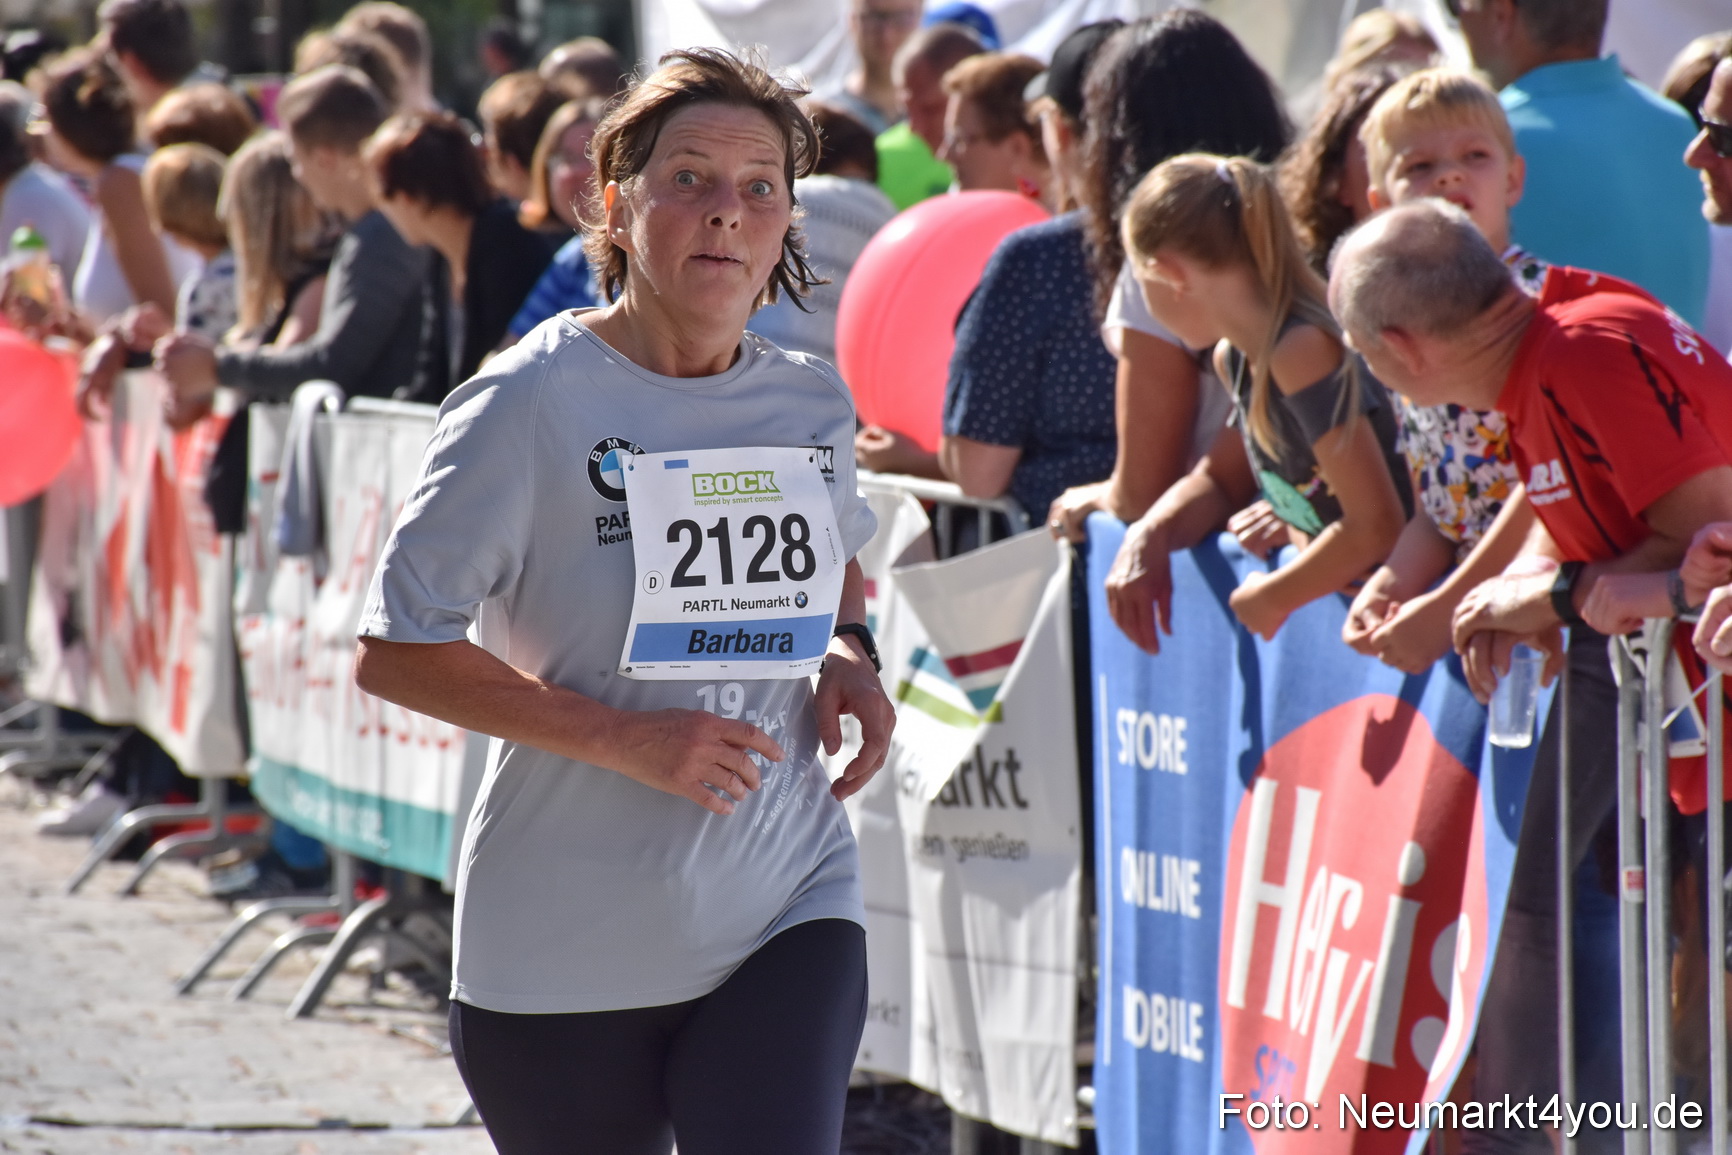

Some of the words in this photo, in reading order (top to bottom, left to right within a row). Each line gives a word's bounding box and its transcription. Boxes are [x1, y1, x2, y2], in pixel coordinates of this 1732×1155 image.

[590, 438, 641, 462] BMW
[693, 472, 778, 495] BOCK
[694, 497, 720, 507] inspired
[722, 497, 730, 506] by
[732, 496, 753, 504] smart
[755, 495, 784, 504] concepts
[666, 513, 816, 588] 2128
[649, 577, 657, 589] D
[682, 599, 728, 613] PARTL
[731, 595, 790, 611] Neumarkt
[687, 628, 794, 654] Barbara
[1116, 707, 1188, 775] STORE
[770, 761, 794, 821] September
[787, 737, 798, 764] 2018
[929, 744, 1030, 809] arkt
[1120, 846, 1201, 919] ONLINE
[1227, 777, 1471, 1105] Hervis
